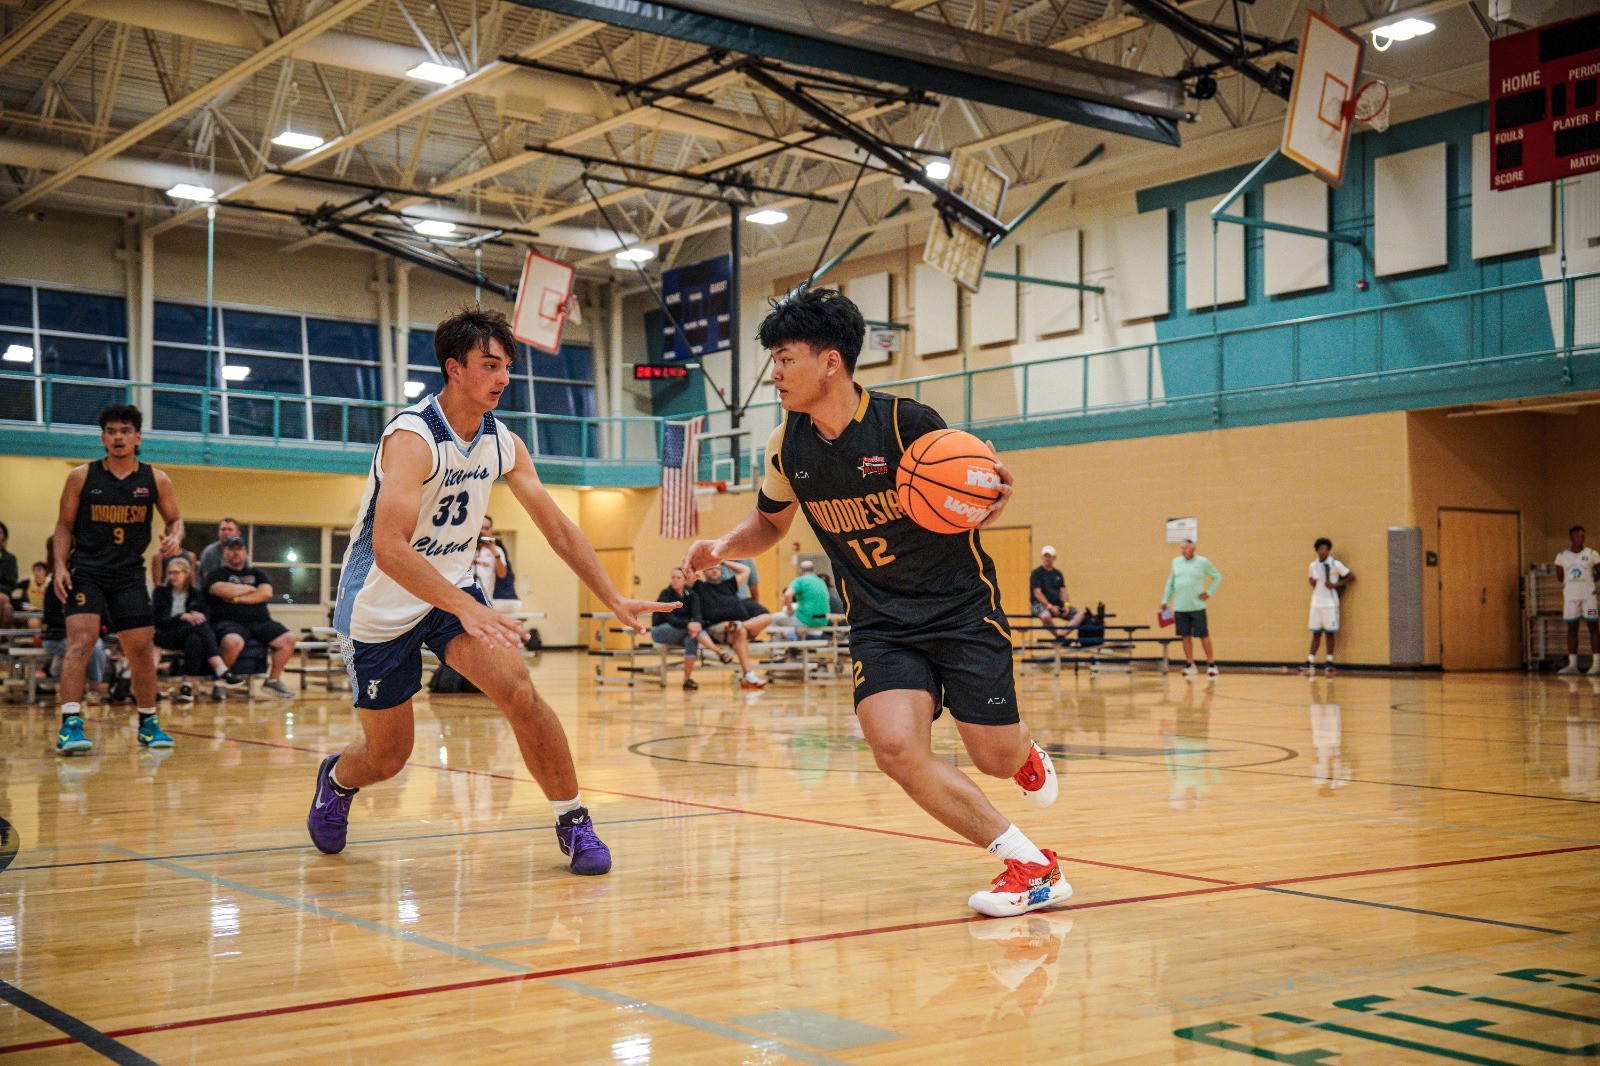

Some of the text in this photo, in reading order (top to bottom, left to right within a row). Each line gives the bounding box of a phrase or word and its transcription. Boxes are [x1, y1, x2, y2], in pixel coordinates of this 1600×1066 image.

[1502, 70, 1541, 94] HOME
[1553, 113, 1589, 131] PLAYER
[1495, 129, 1524, 145] FOULS
[1494, 170, 1524, 186] SCORE
[967, 469, 1000, 489] CAA
[432, 490, 469, 527] 33
[805, 488, 908, 534] INDONESIA
[113, 528, 125, 545] 9
[847, 537, 896, 569] 12
[75, 593, 87, 606] 9
